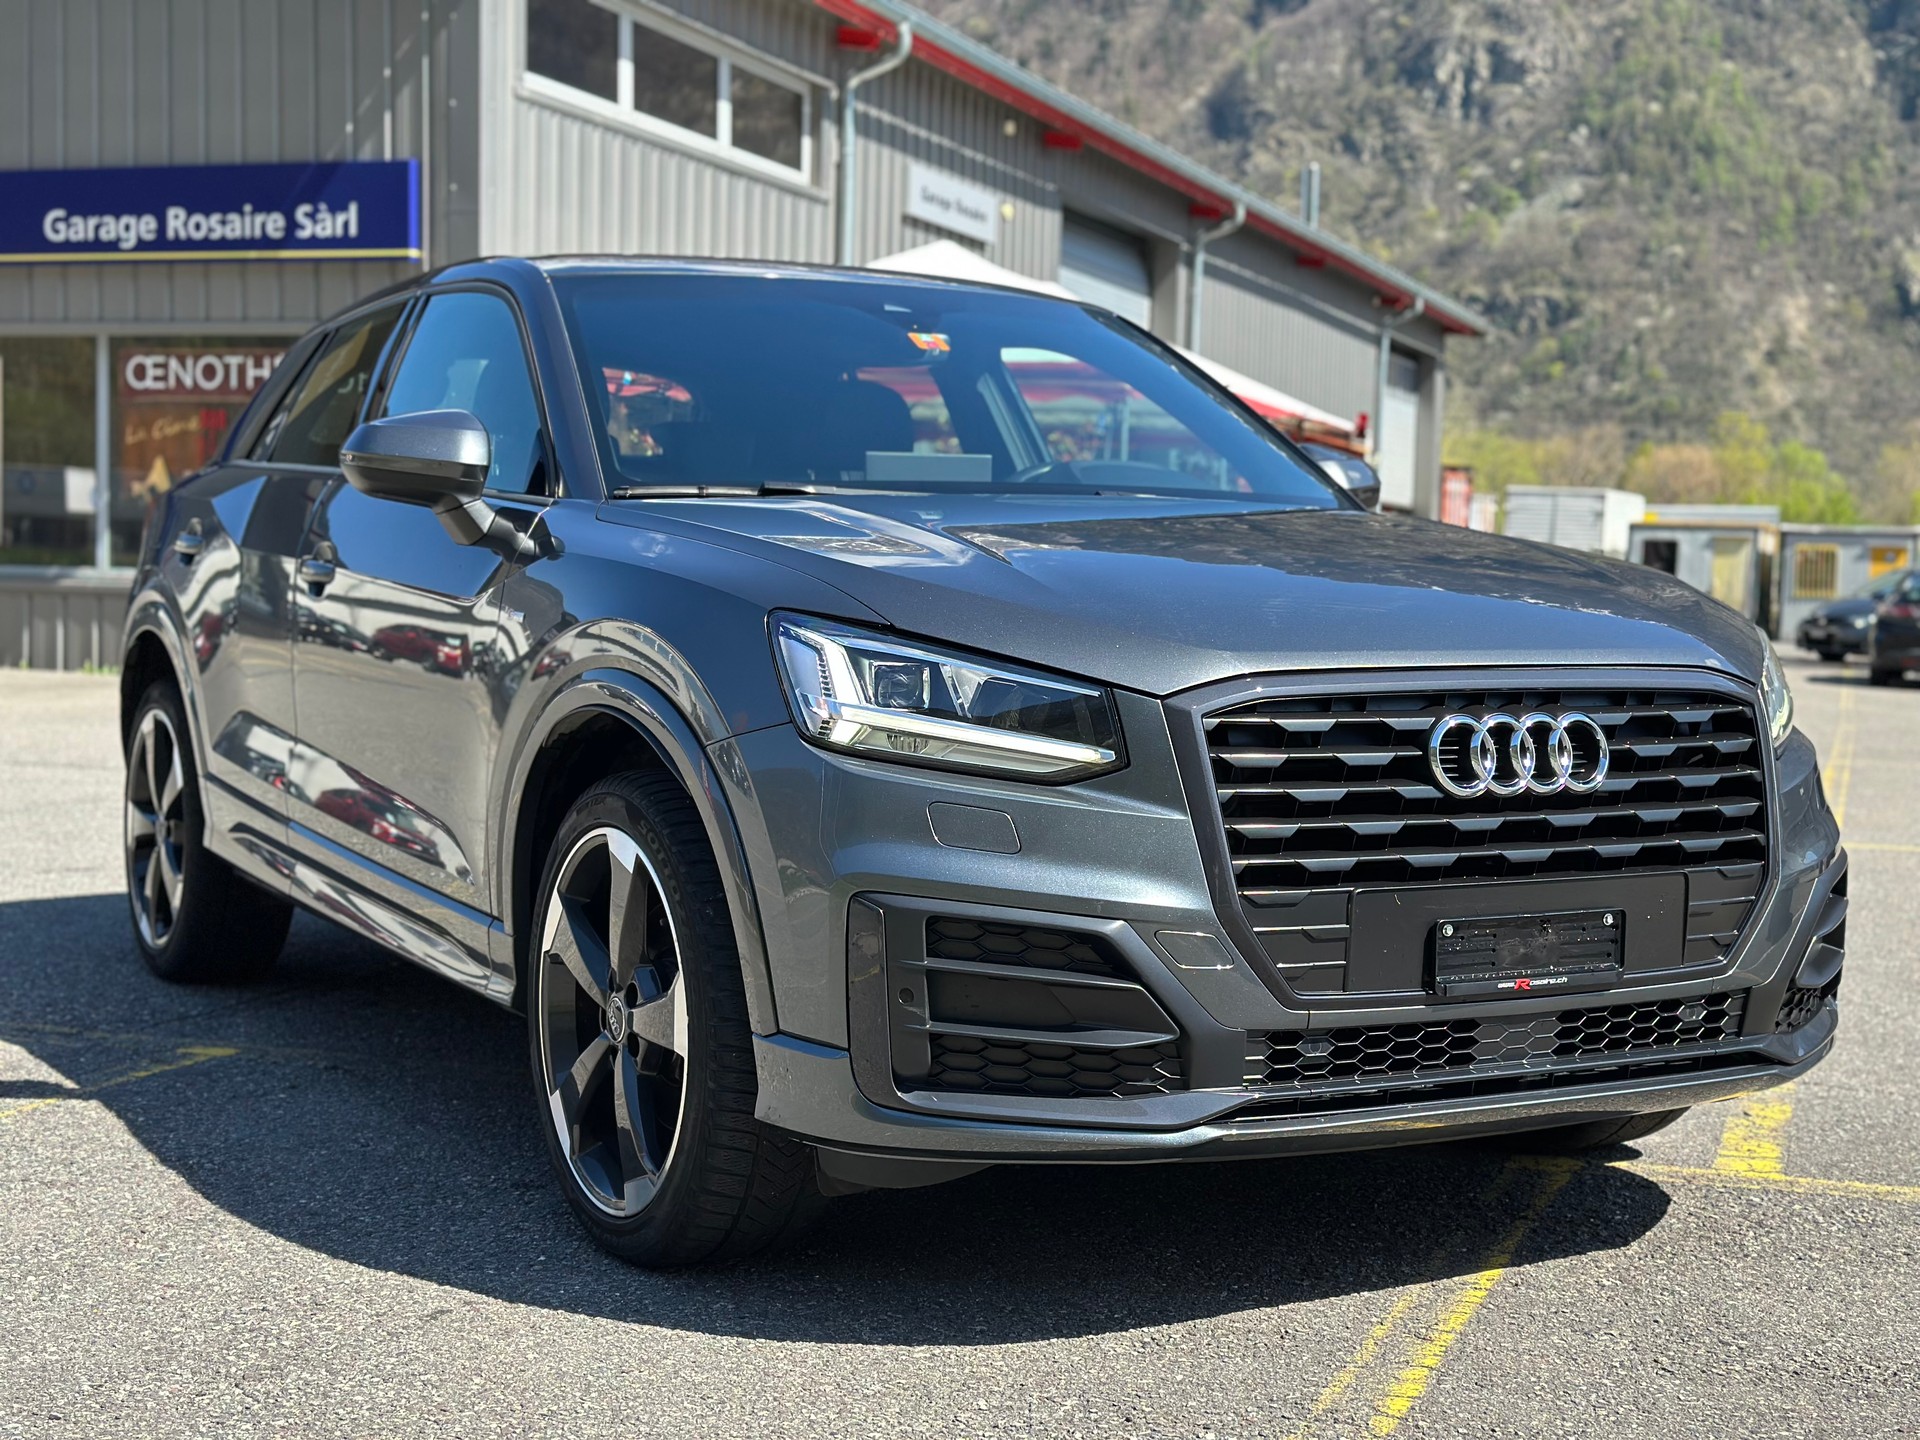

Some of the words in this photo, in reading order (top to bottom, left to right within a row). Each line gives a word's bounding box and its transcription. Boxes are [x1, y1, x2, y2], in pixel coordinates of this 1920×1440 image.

[43, 208, 157, 250] Garage
[166, 203, 286, 241] Rosaire
[294, 201, 359, 239] Sàrl
